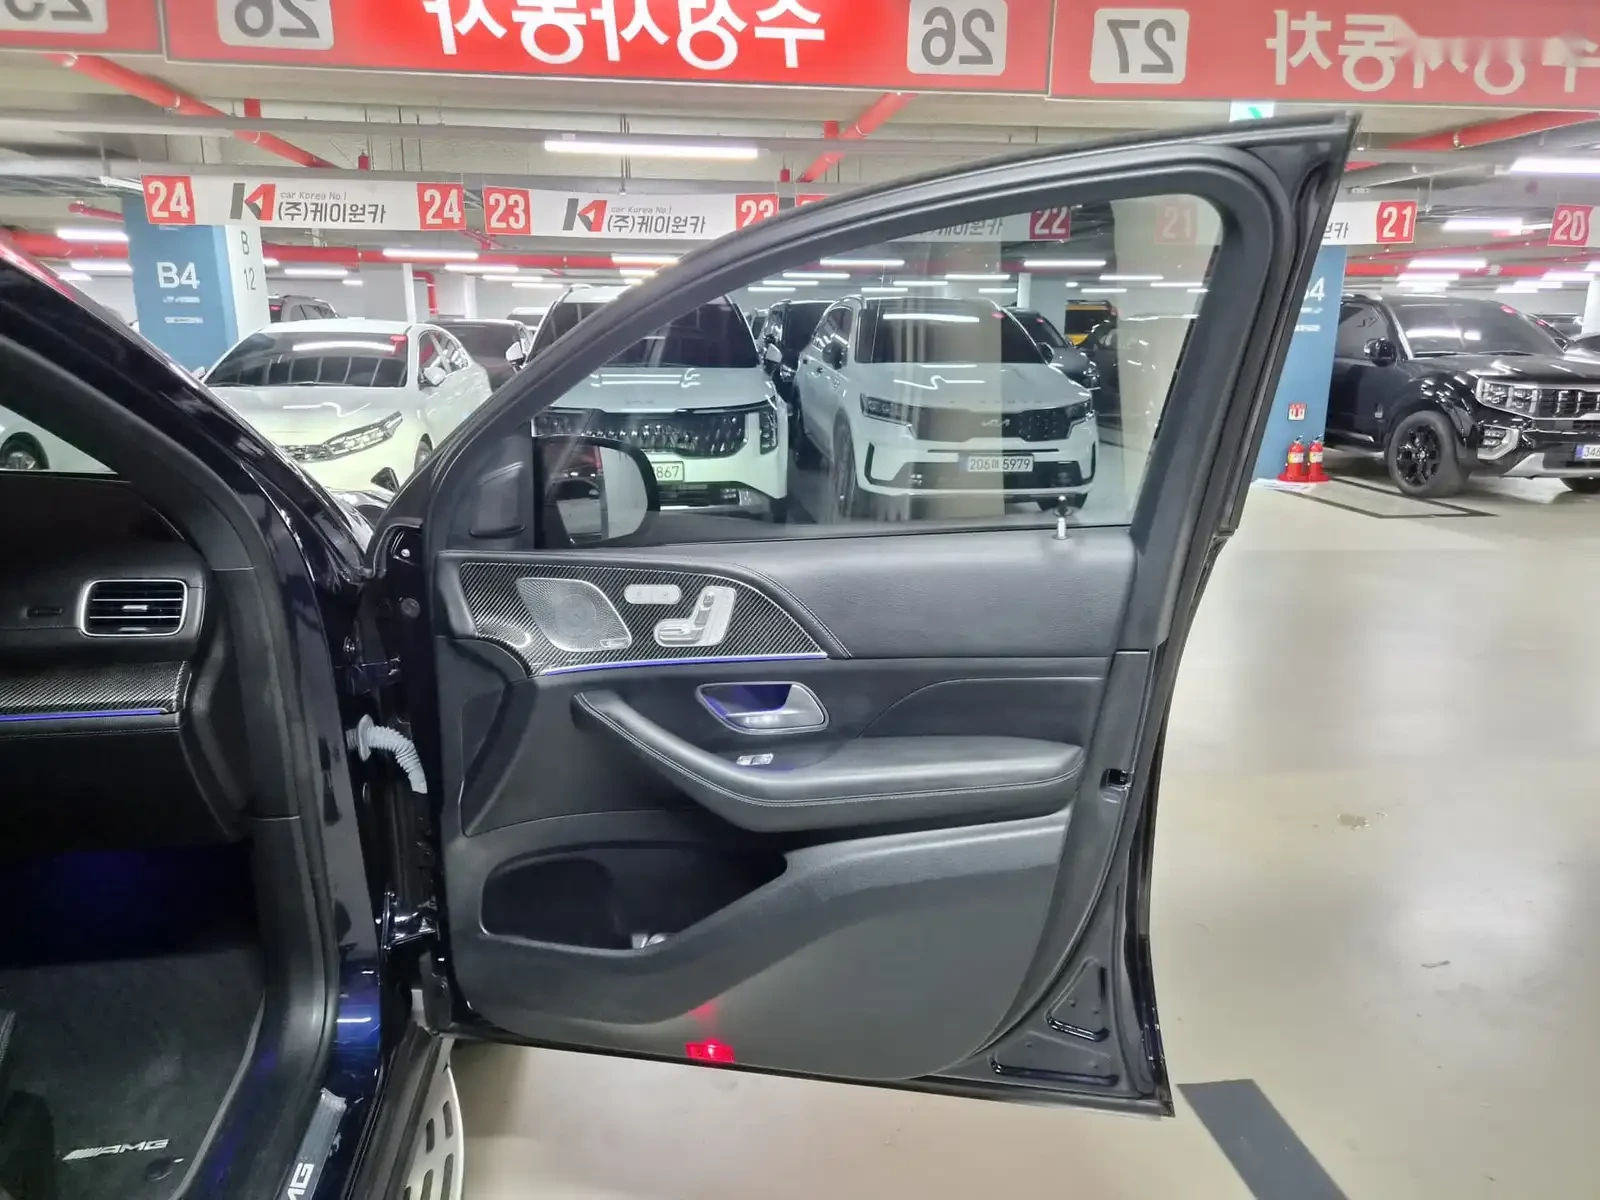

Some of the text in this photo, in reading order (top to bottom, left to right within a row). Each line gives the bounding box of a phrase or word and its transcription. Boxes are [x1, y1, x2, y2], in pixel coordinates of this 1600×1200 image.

[149, 180, 191, 219] 24
[278, 201, 387, 223] (주)케이원카
[423, 188, 462, 225] 24
[489, 192, 527, 230] 23
[607, 215, 706, 234] (주)케이원카
[1034, 206, 1068, 235] 22
[1163, 207, 1193, 239] 21
[1381, 205, 1412, 238] 21
[1554, 210, 1586, 241] 20
[241, 230, 250, 255] B
[156, 261, 200, 289] B4
[244, 267, 256, 290] 12
[1304, 276, 1325, 301] 4
[1002, 458, 1031, 471] 5979
[98, 1139, 169, 1156] AMG
